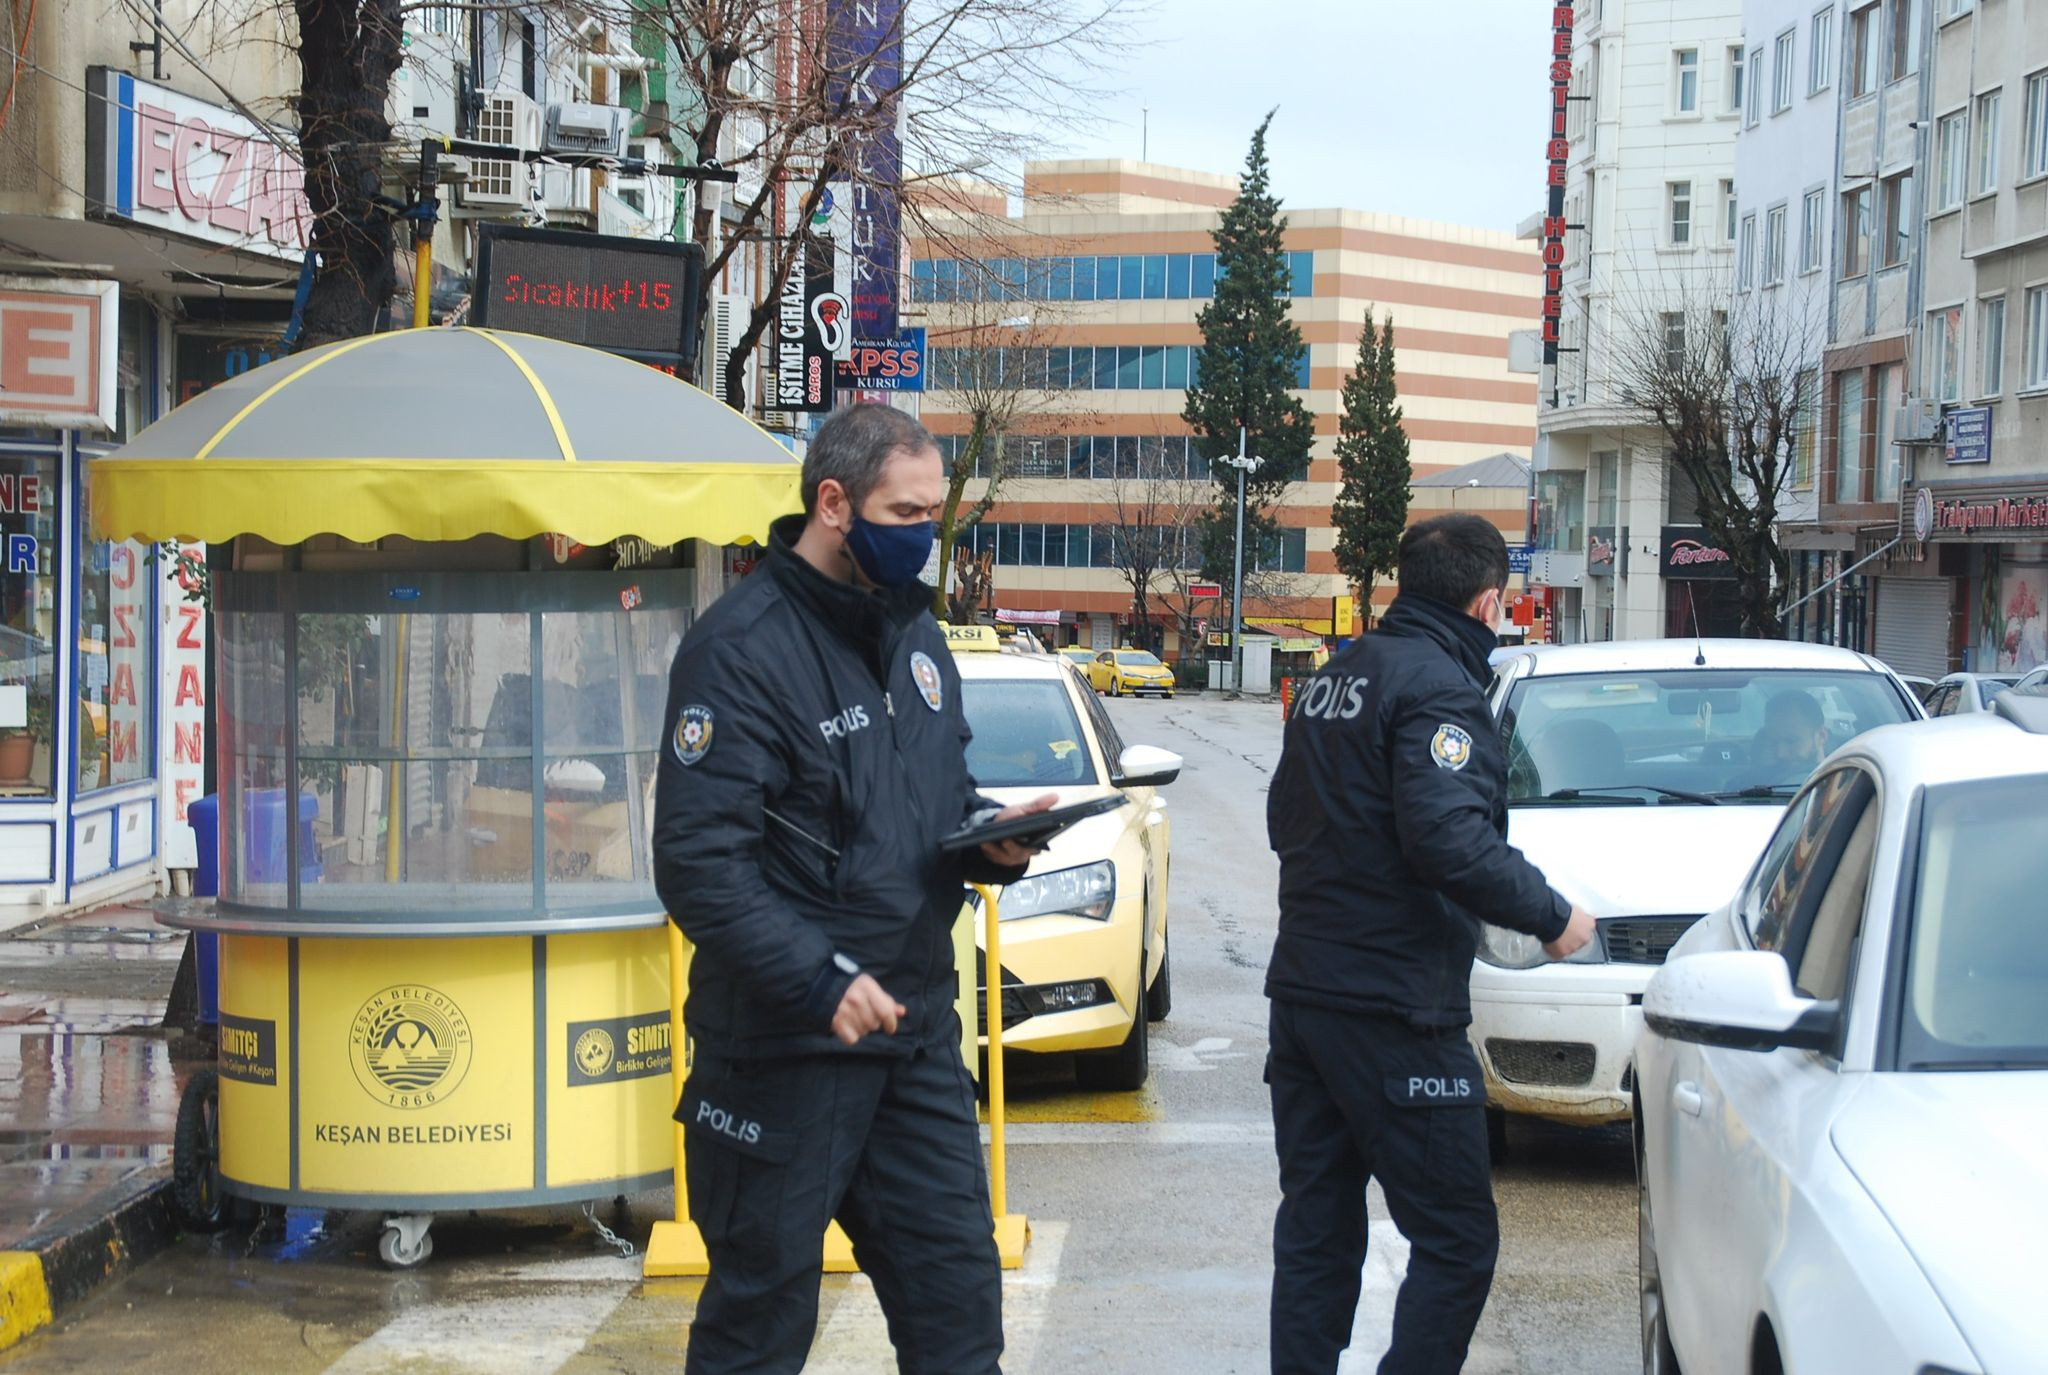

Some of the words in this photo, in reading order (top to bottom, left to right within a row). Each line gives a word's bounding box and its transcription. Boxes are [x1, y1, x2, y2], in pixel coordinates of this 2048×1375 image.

[1542, 216, 1566, 343] HOTEL
[839, 348, 920, 377] KPSS
[808, 355, 822, 404] SAROS
[856, 377, 901, 389] KURSU
[388, 1090, 436, 1108] 1866
[315, 1123, 381, 1146] KEŞAN
